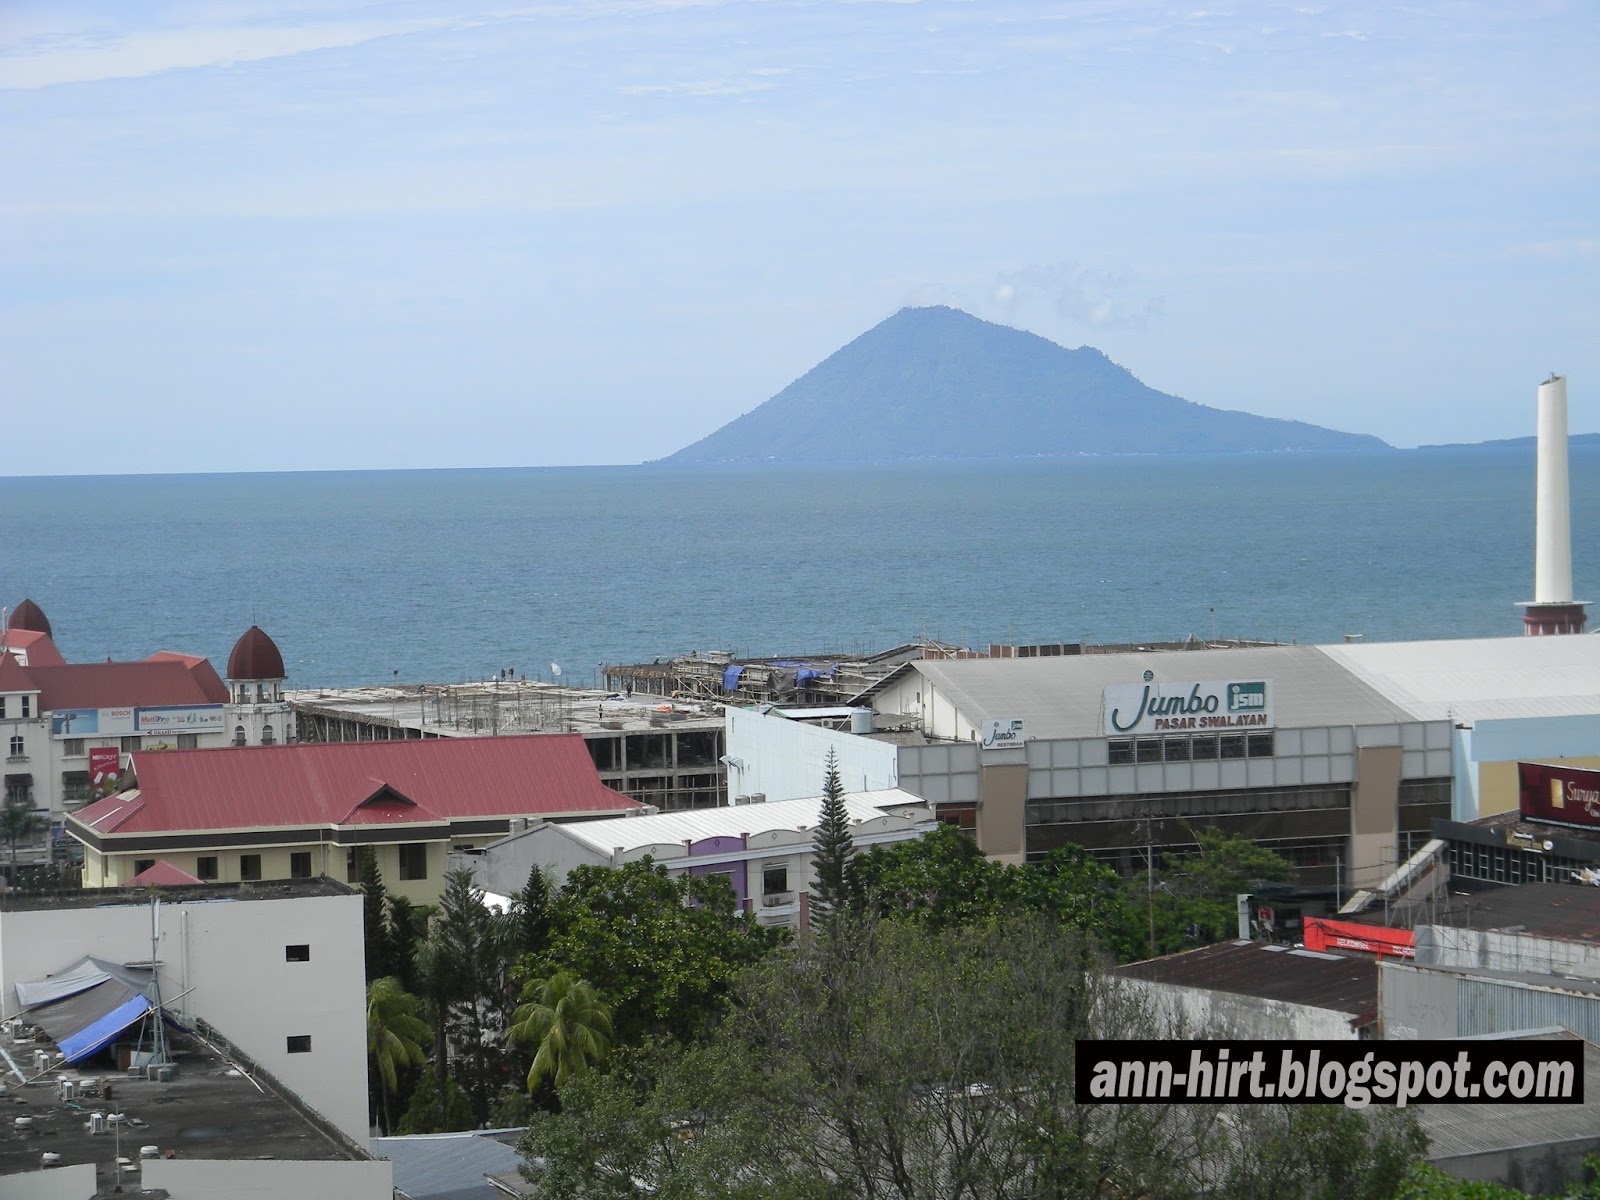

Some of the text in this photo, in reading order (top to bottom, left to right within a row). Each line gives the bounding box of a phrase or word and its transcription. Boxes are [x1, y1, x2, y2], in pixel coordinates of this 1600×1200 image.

[1112, 670, 1219, 732] Jumbo
[1230, 686, 1264, 711] jsm
[1155, 713, 1267, 731] PASAR SWALAYAN
[1566, 781, 1600, 812] Surya
